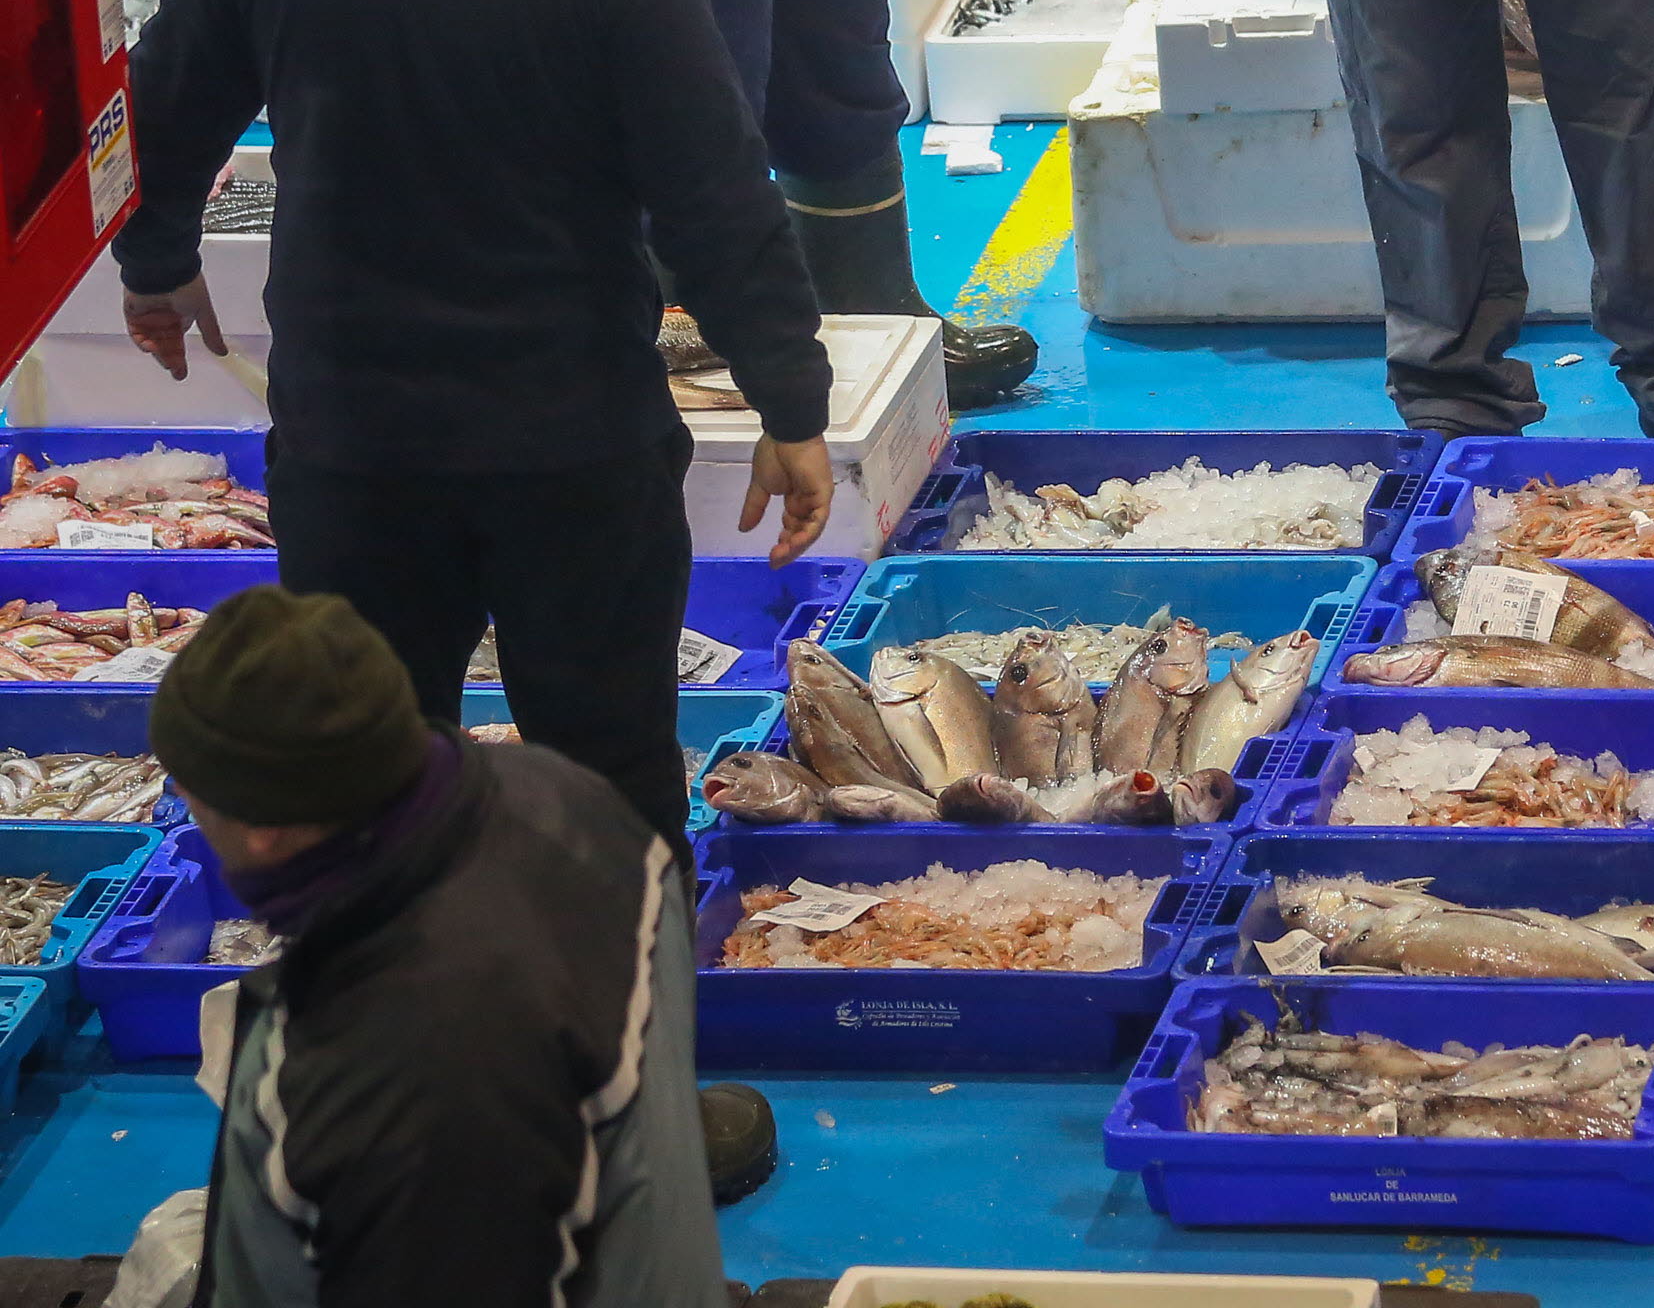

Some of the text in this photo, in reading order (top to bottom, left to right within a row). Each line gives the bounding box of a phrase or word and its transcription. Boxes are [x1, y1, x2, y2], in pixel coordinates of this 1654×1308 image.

[89, 95, 124, 162] PRS
[861, 1001, 894, 1010] LONJA
[896, 1001, 910, 1009] DE
[1385, 1180, 1399, 1189] DE
[1330, 1192, 1458, 1204] SANLUCAR DE BARRAMEDA
